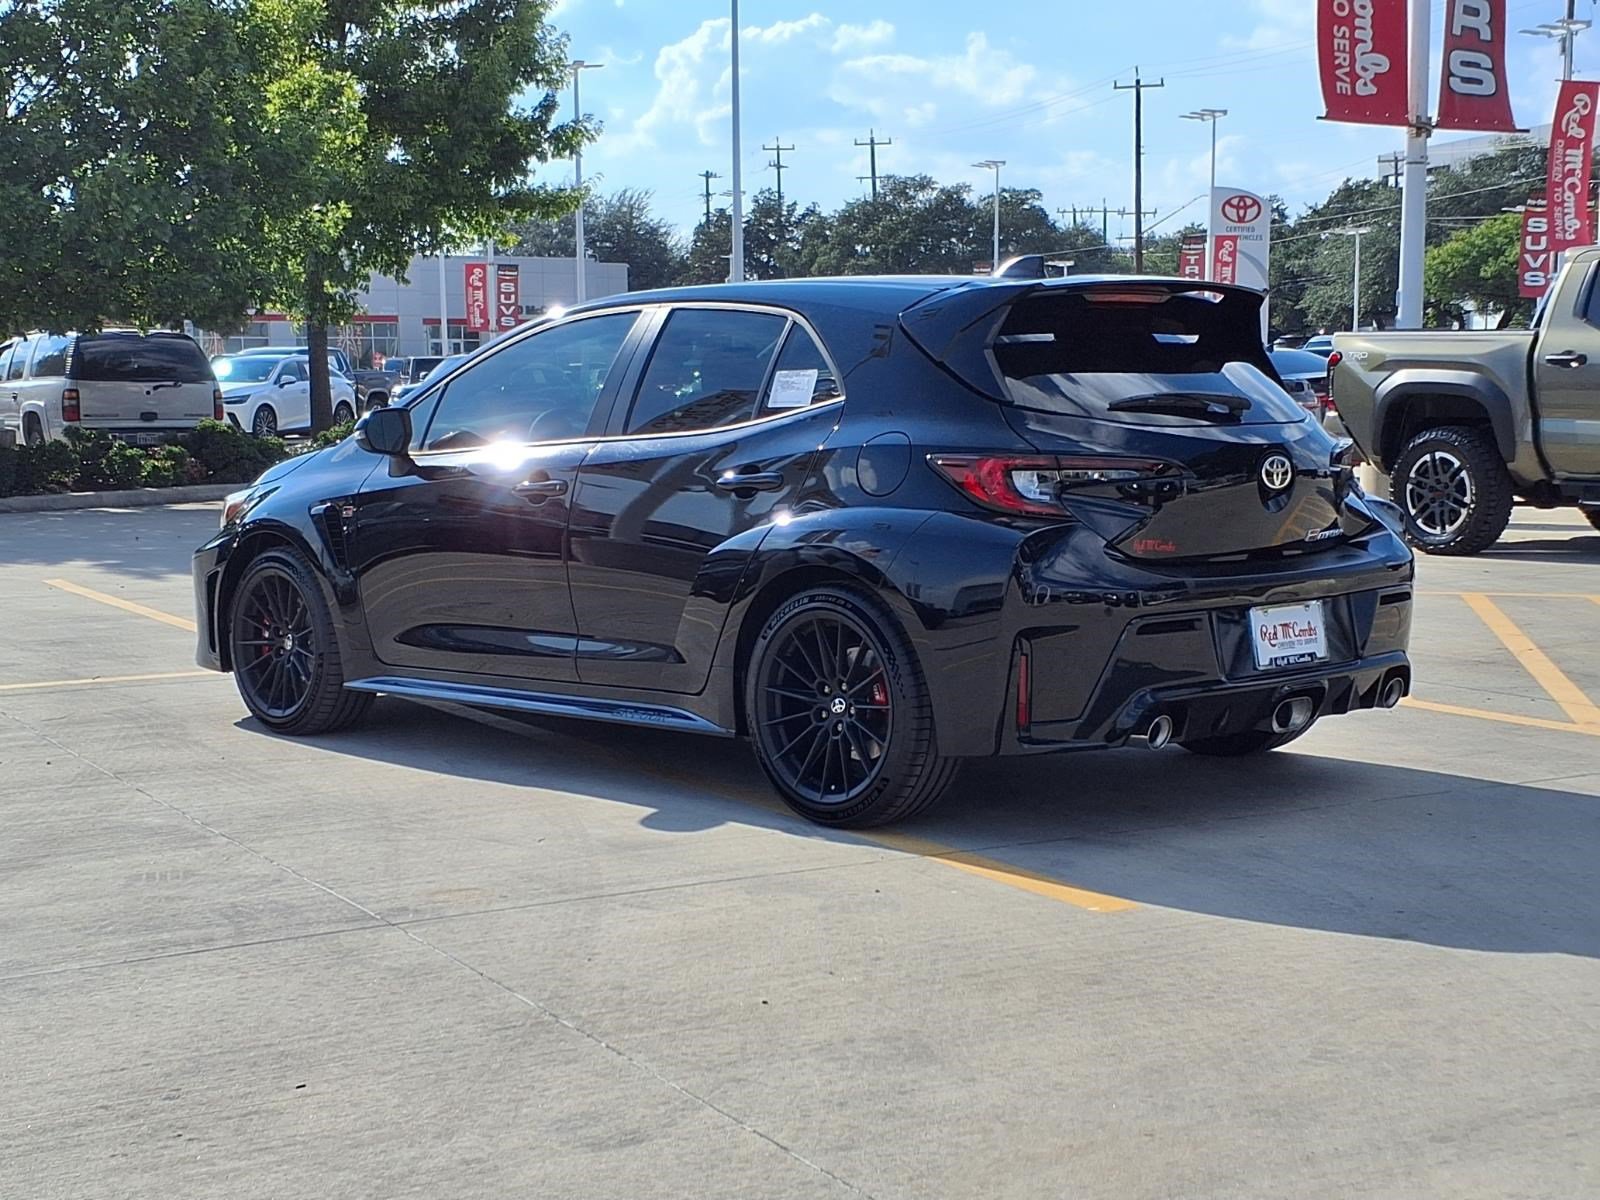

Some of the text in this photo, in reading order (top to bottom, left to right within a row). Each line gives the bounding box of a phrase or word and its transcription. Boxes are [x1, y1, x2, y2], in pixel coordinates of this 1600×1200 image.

[1333, 24, 1351, 96] SERVE
[1448, 0, 1496, 96] RS
[1552, 138, 1565, 241] DRIVEN TO SERVE
[1561, 93, 1591, 240] Red McCombs
[469, 267, 484, 287] Red
[1218, 240, 1234, 263] Red
[1523, 217, 1548, 287] SUVS
[472, 287, 485, 328] McCombs
[500, 282, 516, 327] SUVS
[1260, 620, 1318, 648] Red McCombs
